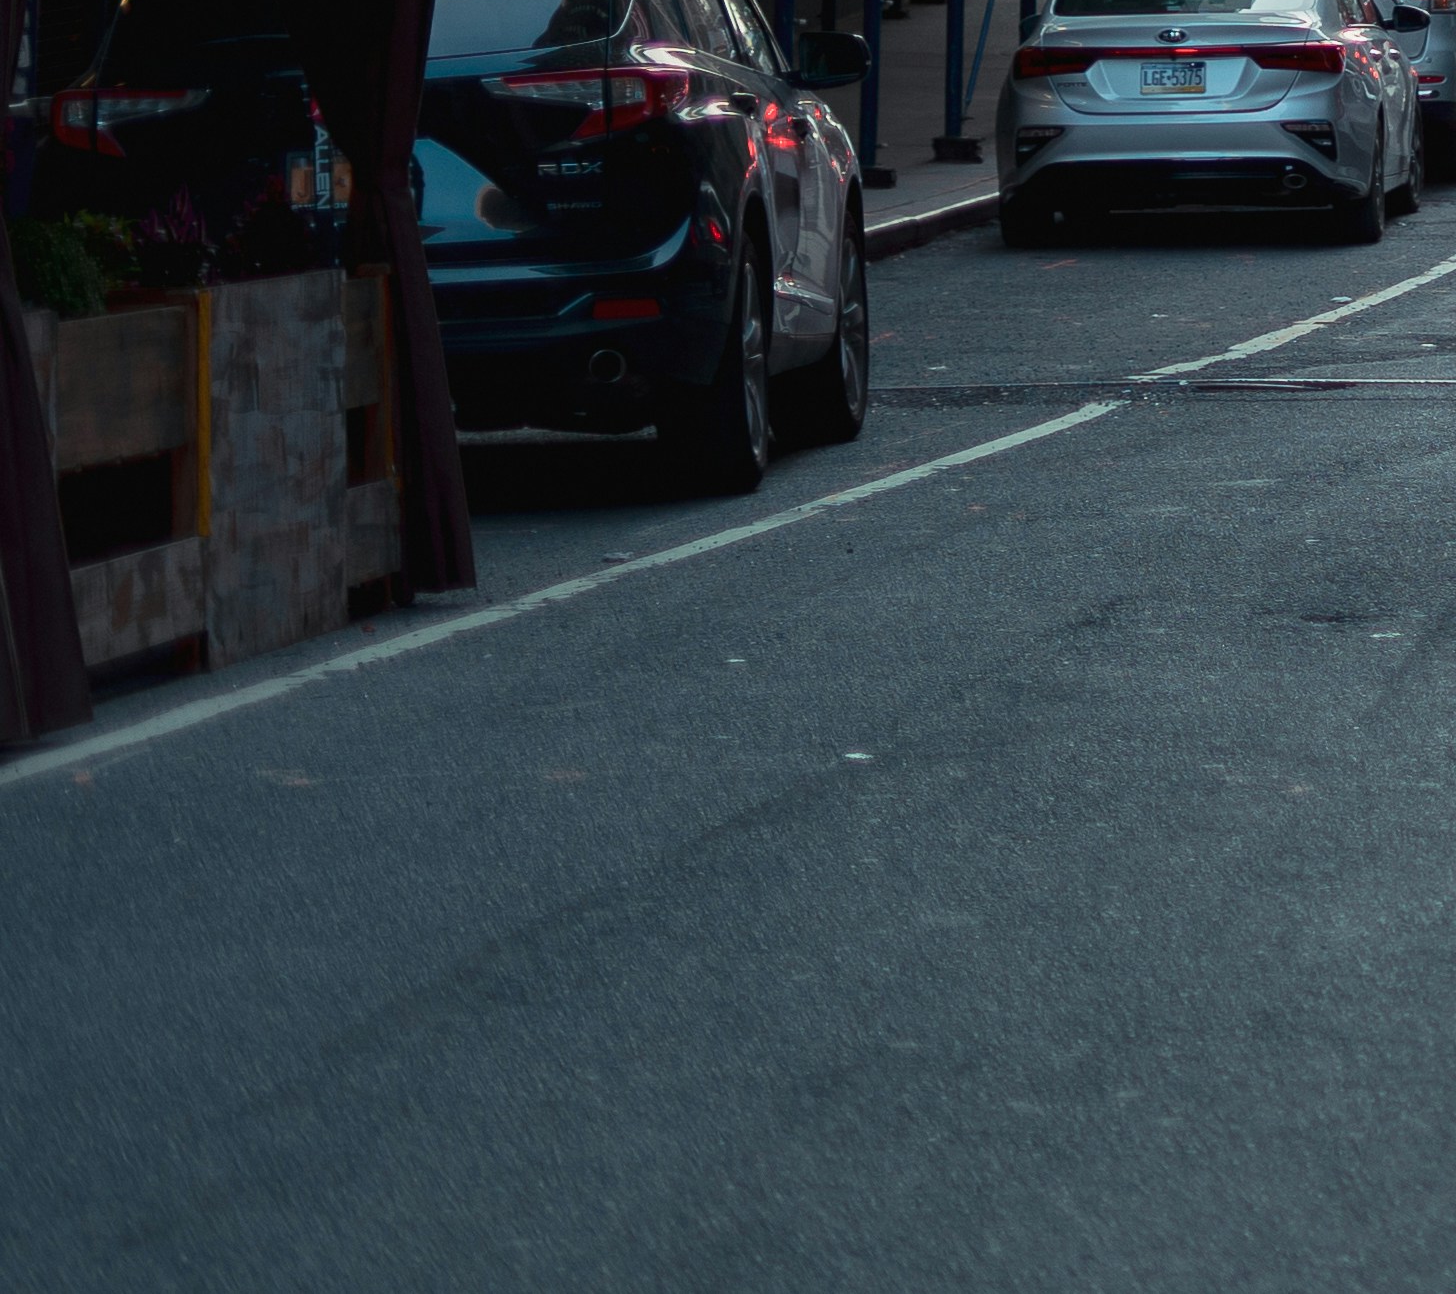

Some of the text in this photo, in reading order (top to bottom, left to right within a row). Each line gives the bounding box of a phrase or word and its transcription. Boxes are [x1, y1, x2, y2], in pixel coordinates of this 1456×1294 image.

[1143, 69, 1203, 87] LGE 5375
[313, 122, 332, 212] ALLEN
[537, 161, 605, 178] RDX
